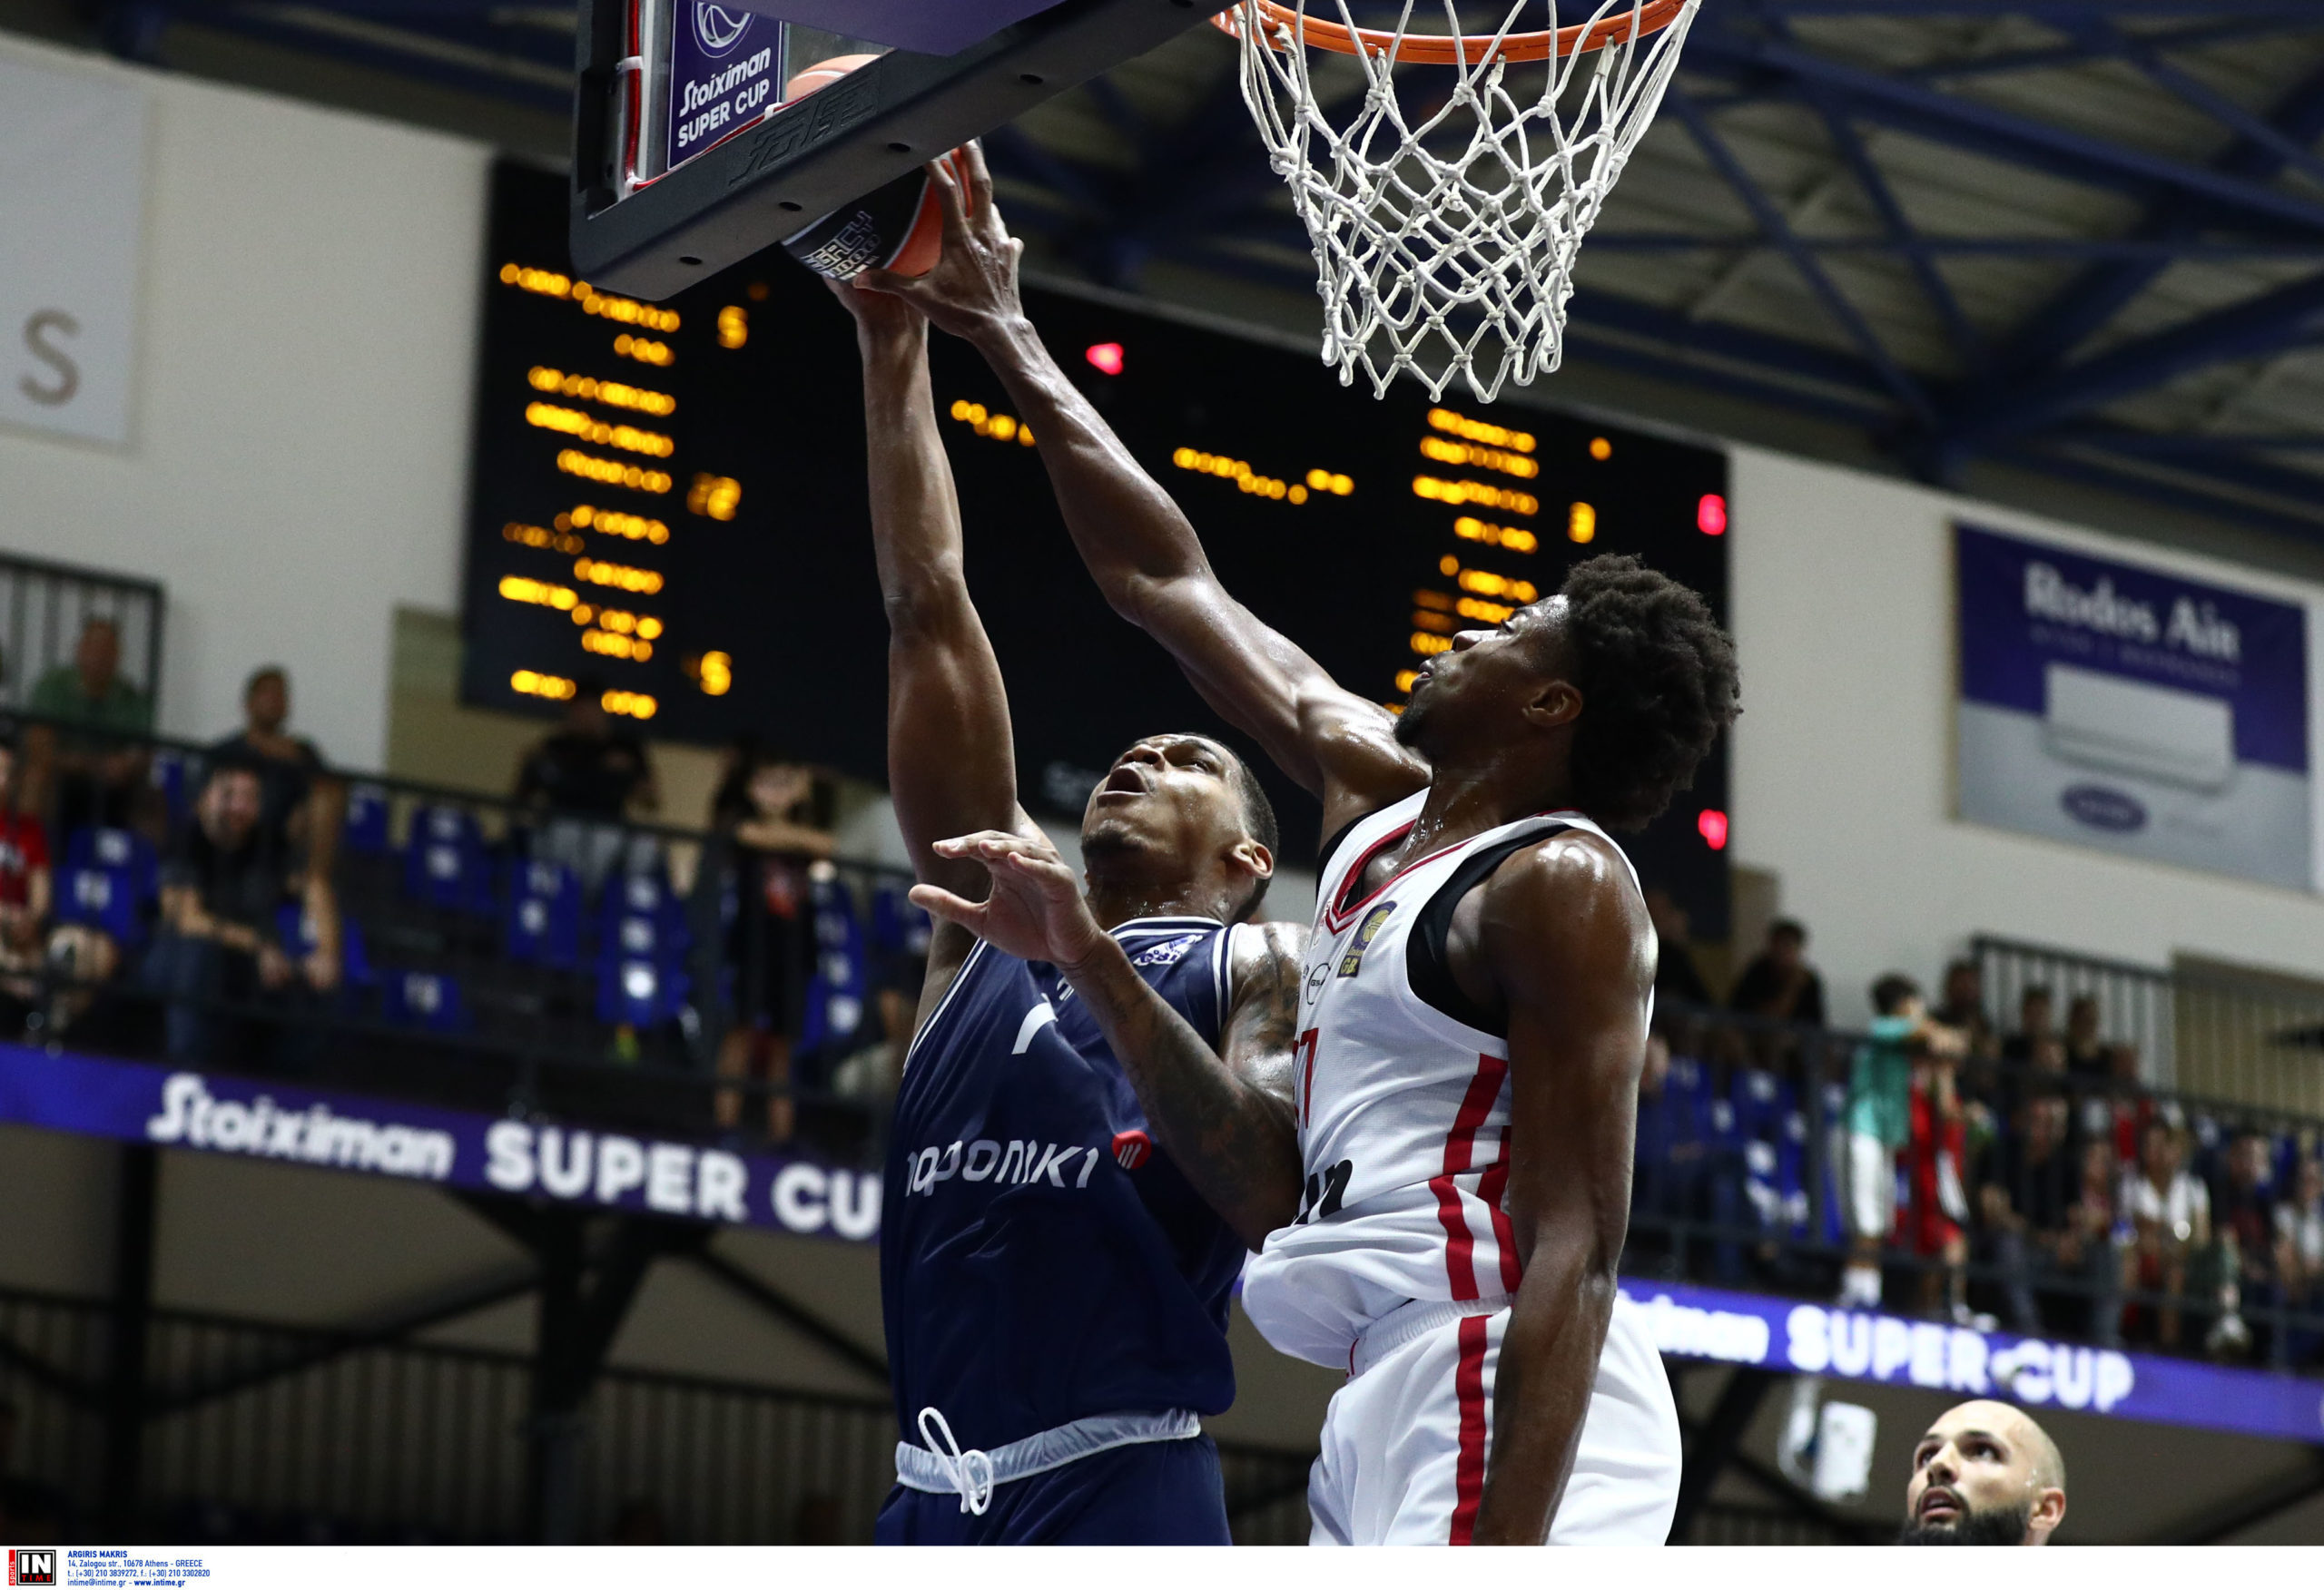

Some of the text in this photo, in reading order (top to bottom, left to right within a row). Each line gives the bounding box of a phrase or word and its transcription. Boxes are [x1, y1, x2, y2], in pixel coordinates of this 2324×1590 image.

[677, 78, 770, 147] SUPER CUP
[679, 47, 772, 118] Stoiximan
[2026, 561, 2158, 643] Rodos
[2166, 597, 2241, 663] Air
[147, 1072, 455, 1181] Stoiximan
[486, 1119, 748, 1222] SUPER
[1787, 1304, 1989, 1395] SUPER
[2013, 1338, 2135, 1413] CUP
